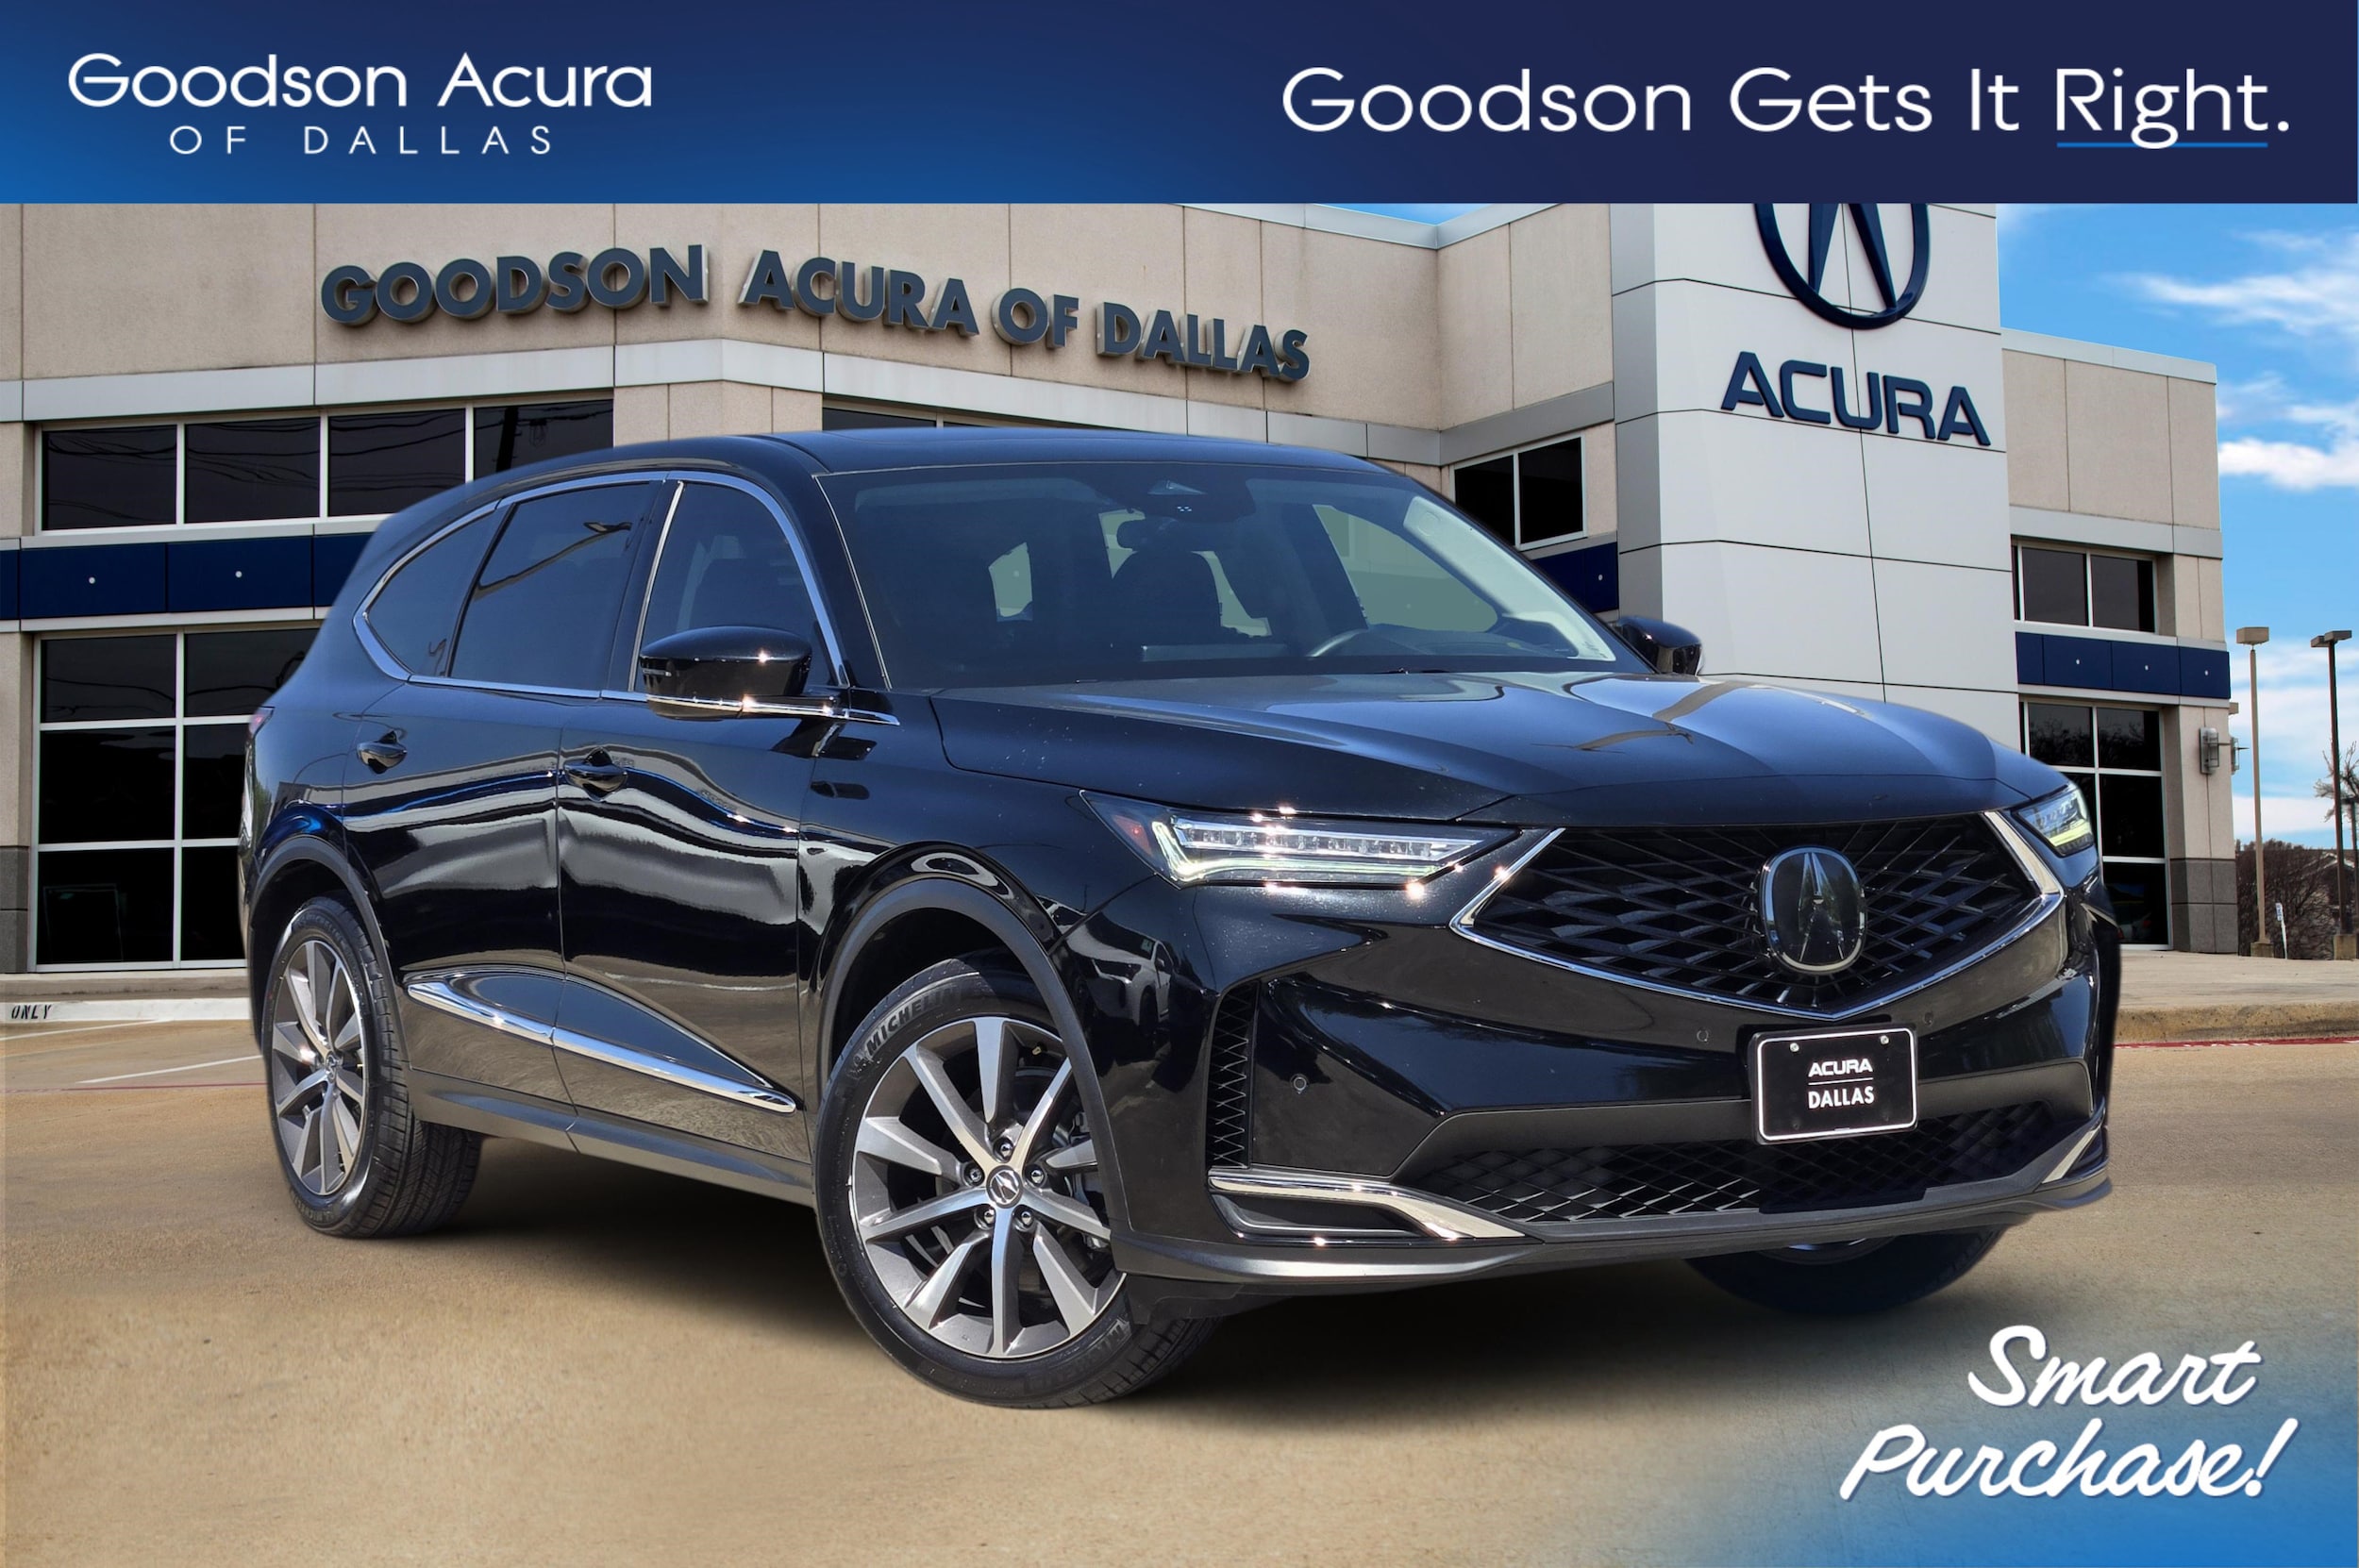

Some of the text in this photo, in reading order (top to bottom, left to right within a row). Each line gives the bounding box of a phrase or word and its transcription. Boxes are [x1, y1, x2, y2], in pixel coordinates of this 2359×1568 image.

[321, 243, 1310, 383] GOODSON ACURA OF DALLAS
[1720, 351, 1991, 446] ACURA
[11, 1005, 52, 1019] ONLY
[1808, 1058, 1874, 1077] ACURA
[1808, 1086, 1875, 1109] DALLAS
